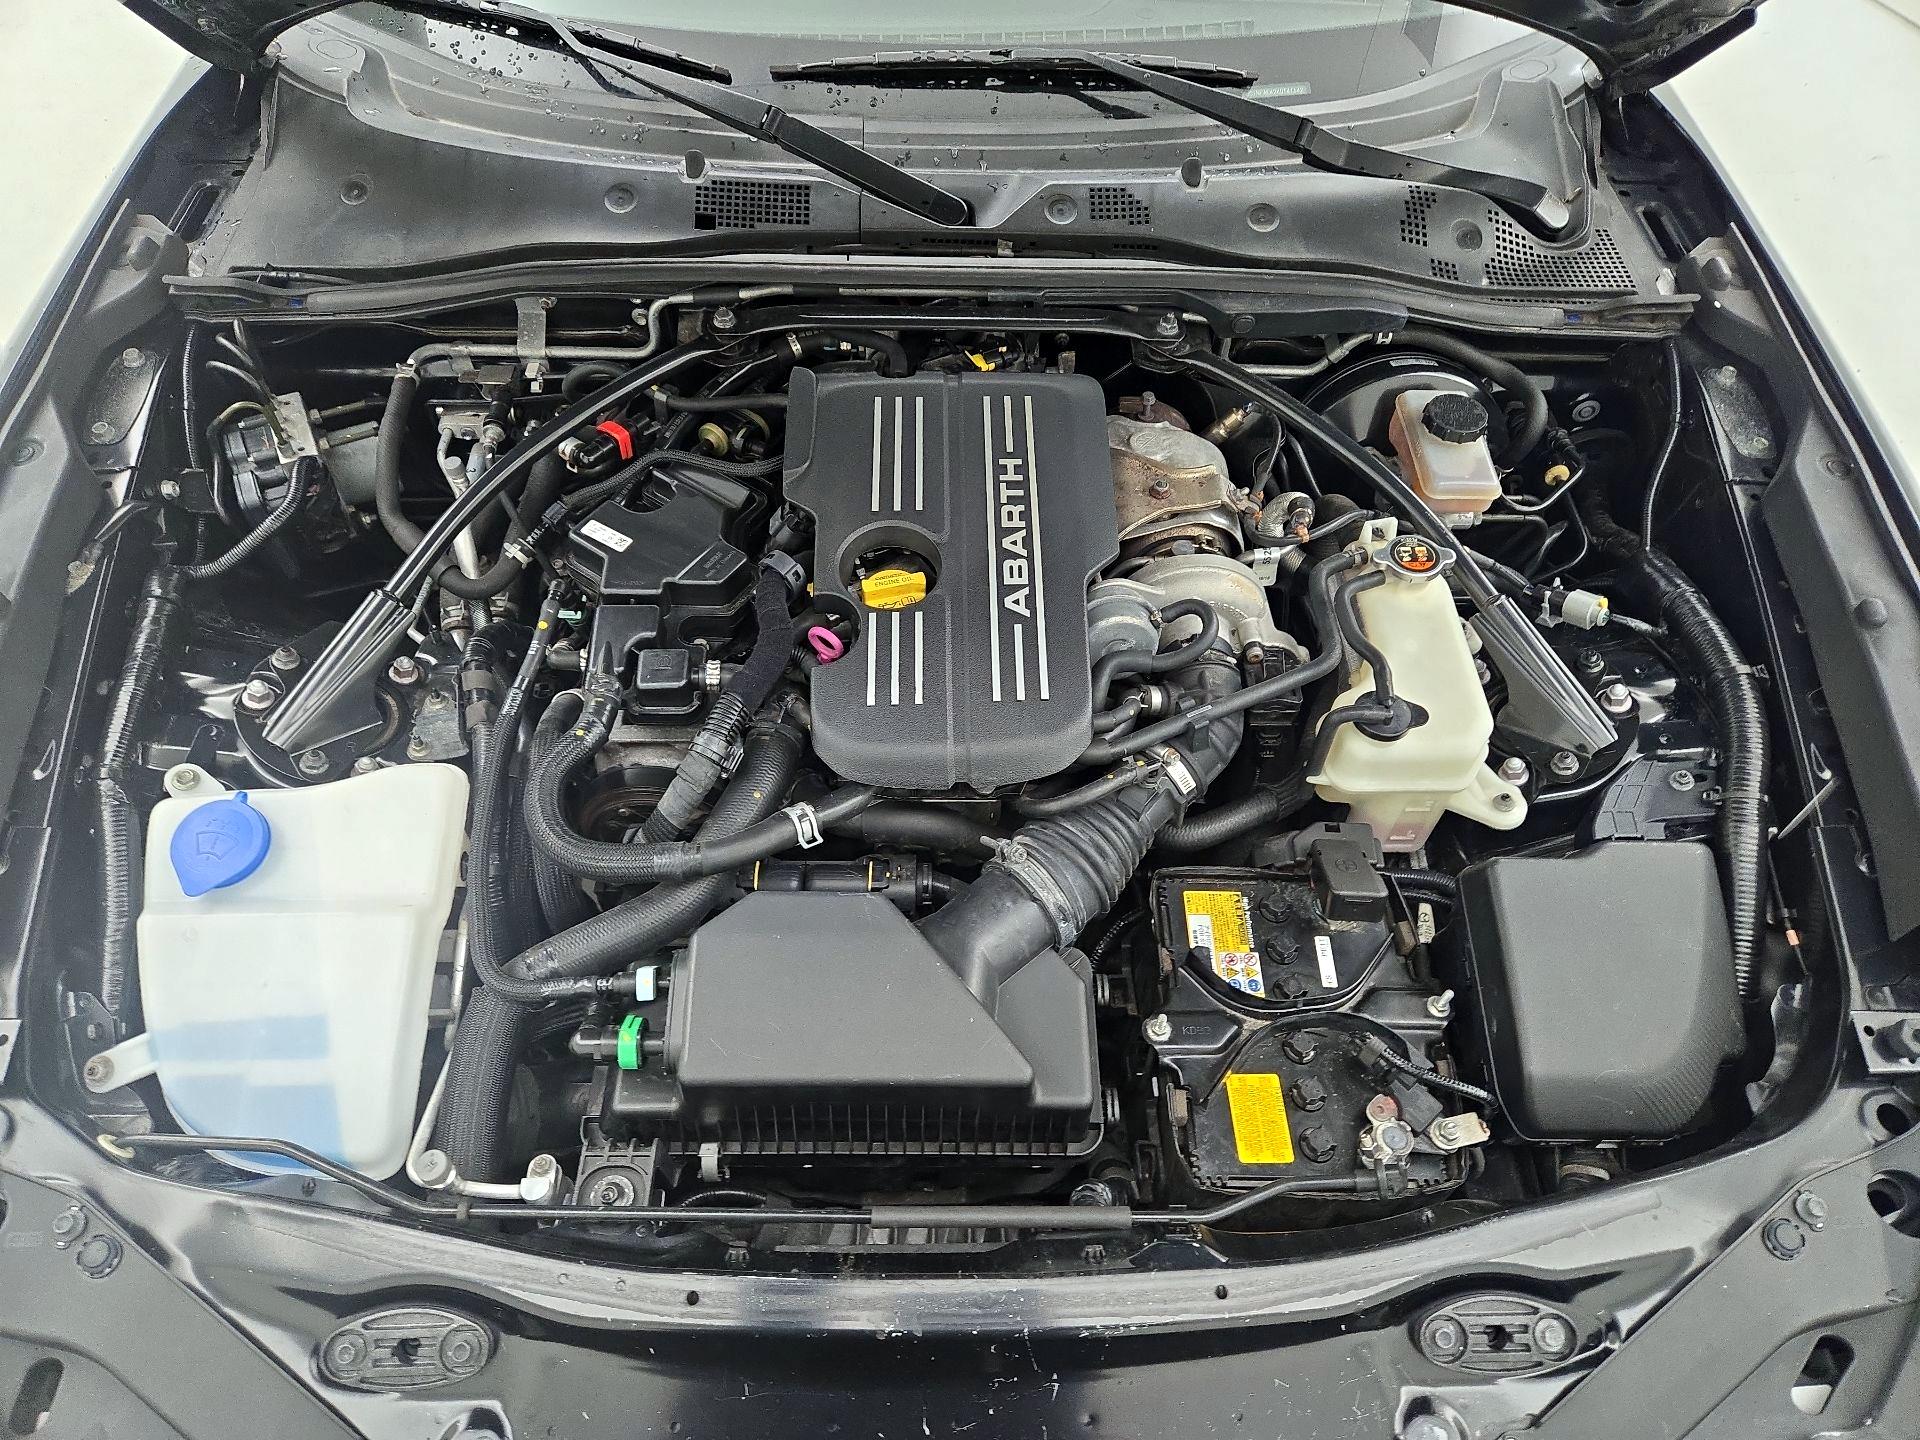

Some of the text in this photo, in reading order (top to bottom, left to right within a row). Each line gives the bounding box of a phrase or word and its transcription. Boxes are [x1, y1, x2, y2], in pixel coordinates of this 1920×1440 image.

[999, 458, 1031, 618] ABARTH
[874, 579, 900, 588] ENGINE
[1241, 896, 1255, 949] High Performance
